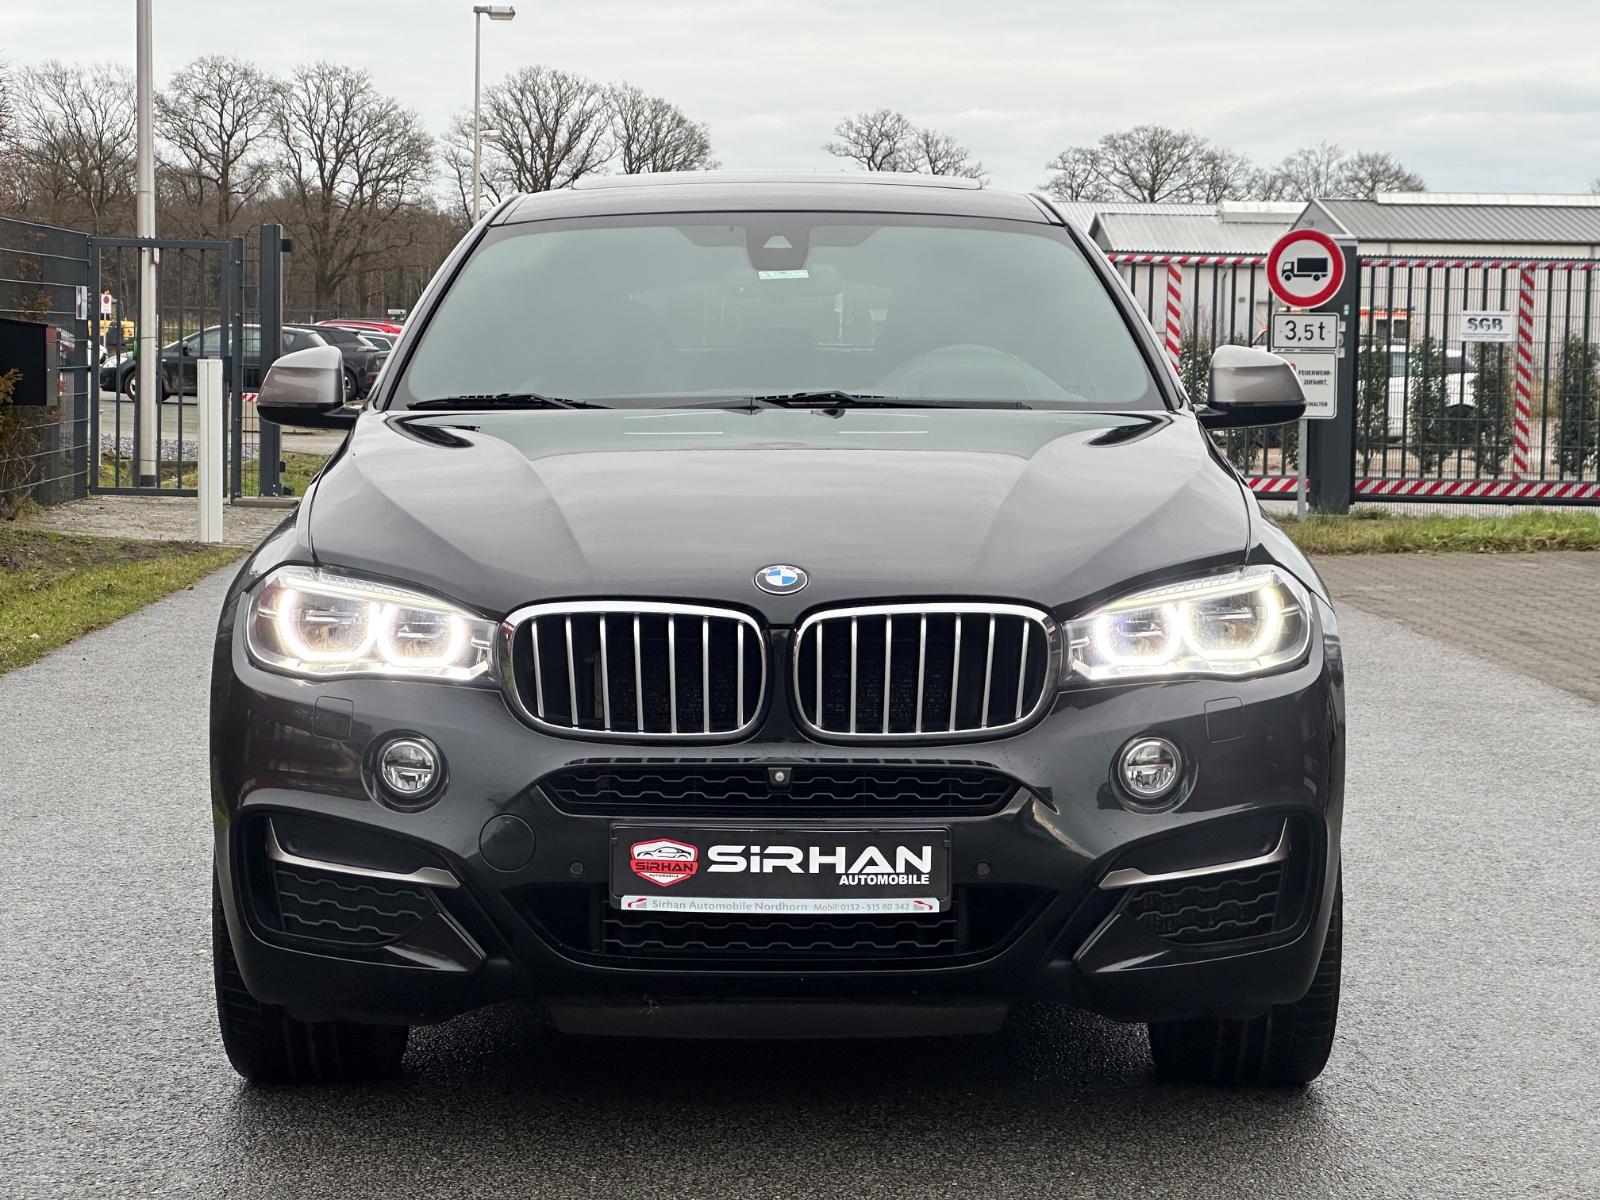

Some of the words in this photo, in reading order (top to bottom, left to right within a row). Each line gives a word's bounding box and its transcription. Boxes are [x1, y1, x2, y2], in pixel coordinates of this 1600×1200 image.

[1467, 317, 1503, 331] SGB
[839, 874, 930, 886] AUTOMOBILE
[652, 899, 686, 909] Sirhan
[688, 901, 752, 911] Automobile
[754, 902, 808, 911] Nordhorn
